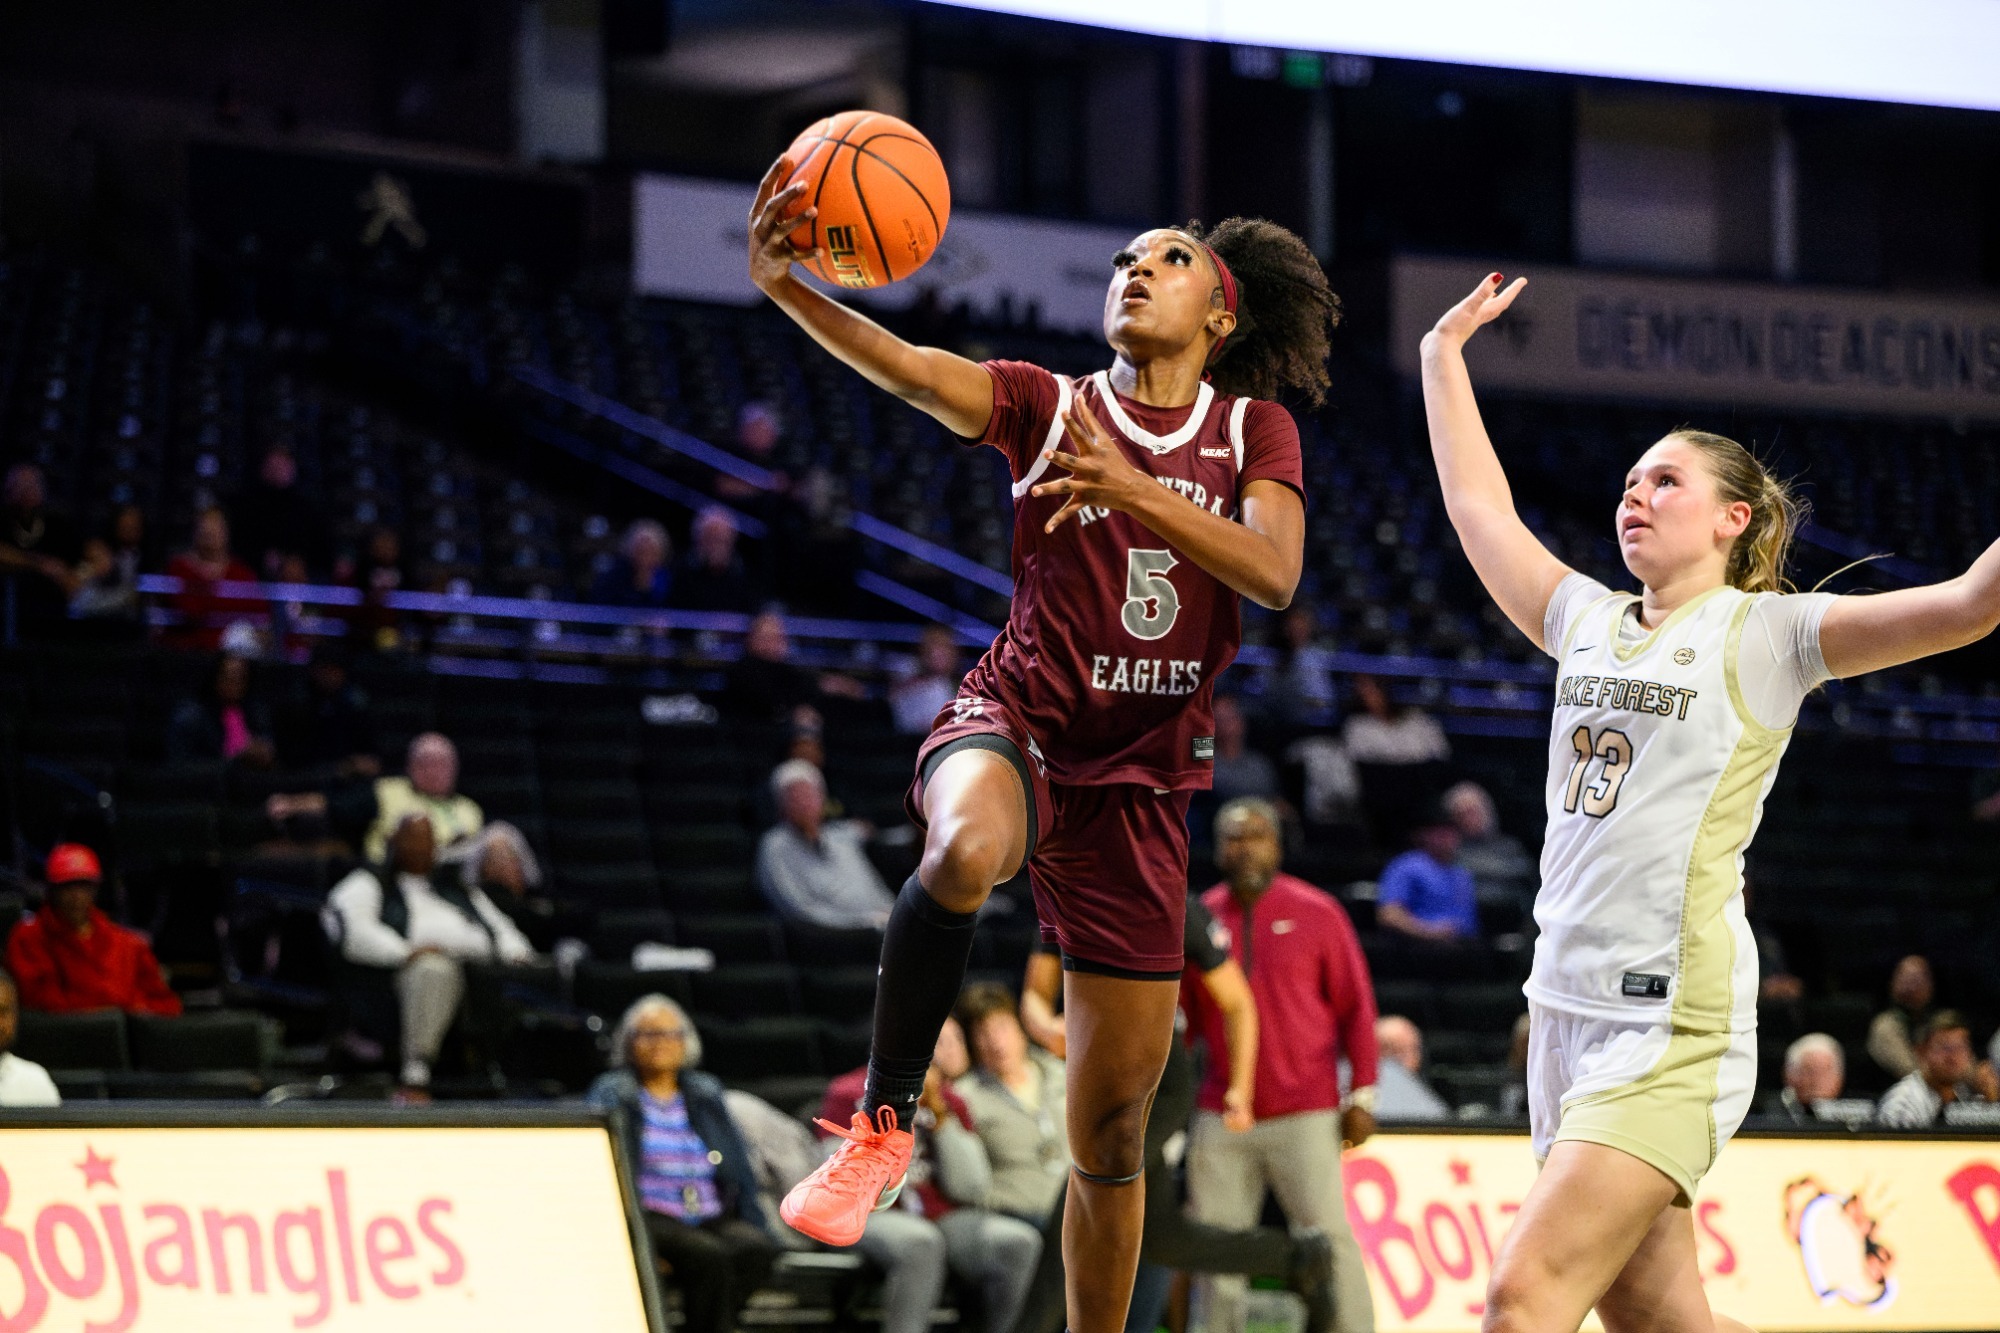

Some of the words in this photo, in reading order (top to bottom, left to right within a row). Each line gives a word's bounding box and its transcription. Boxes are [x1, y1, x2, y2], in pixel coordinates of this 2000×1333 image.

[826, 225, 869, 288] ELITE
[1200, 447, 1231, 458] MEAC
[1121, 548, 1182, 641] 5
[1091, 654, 1202, 696] EAGLES
[1597, 677, 1698, 721] FOREST
[1563, 725, 1634, 818] 13
